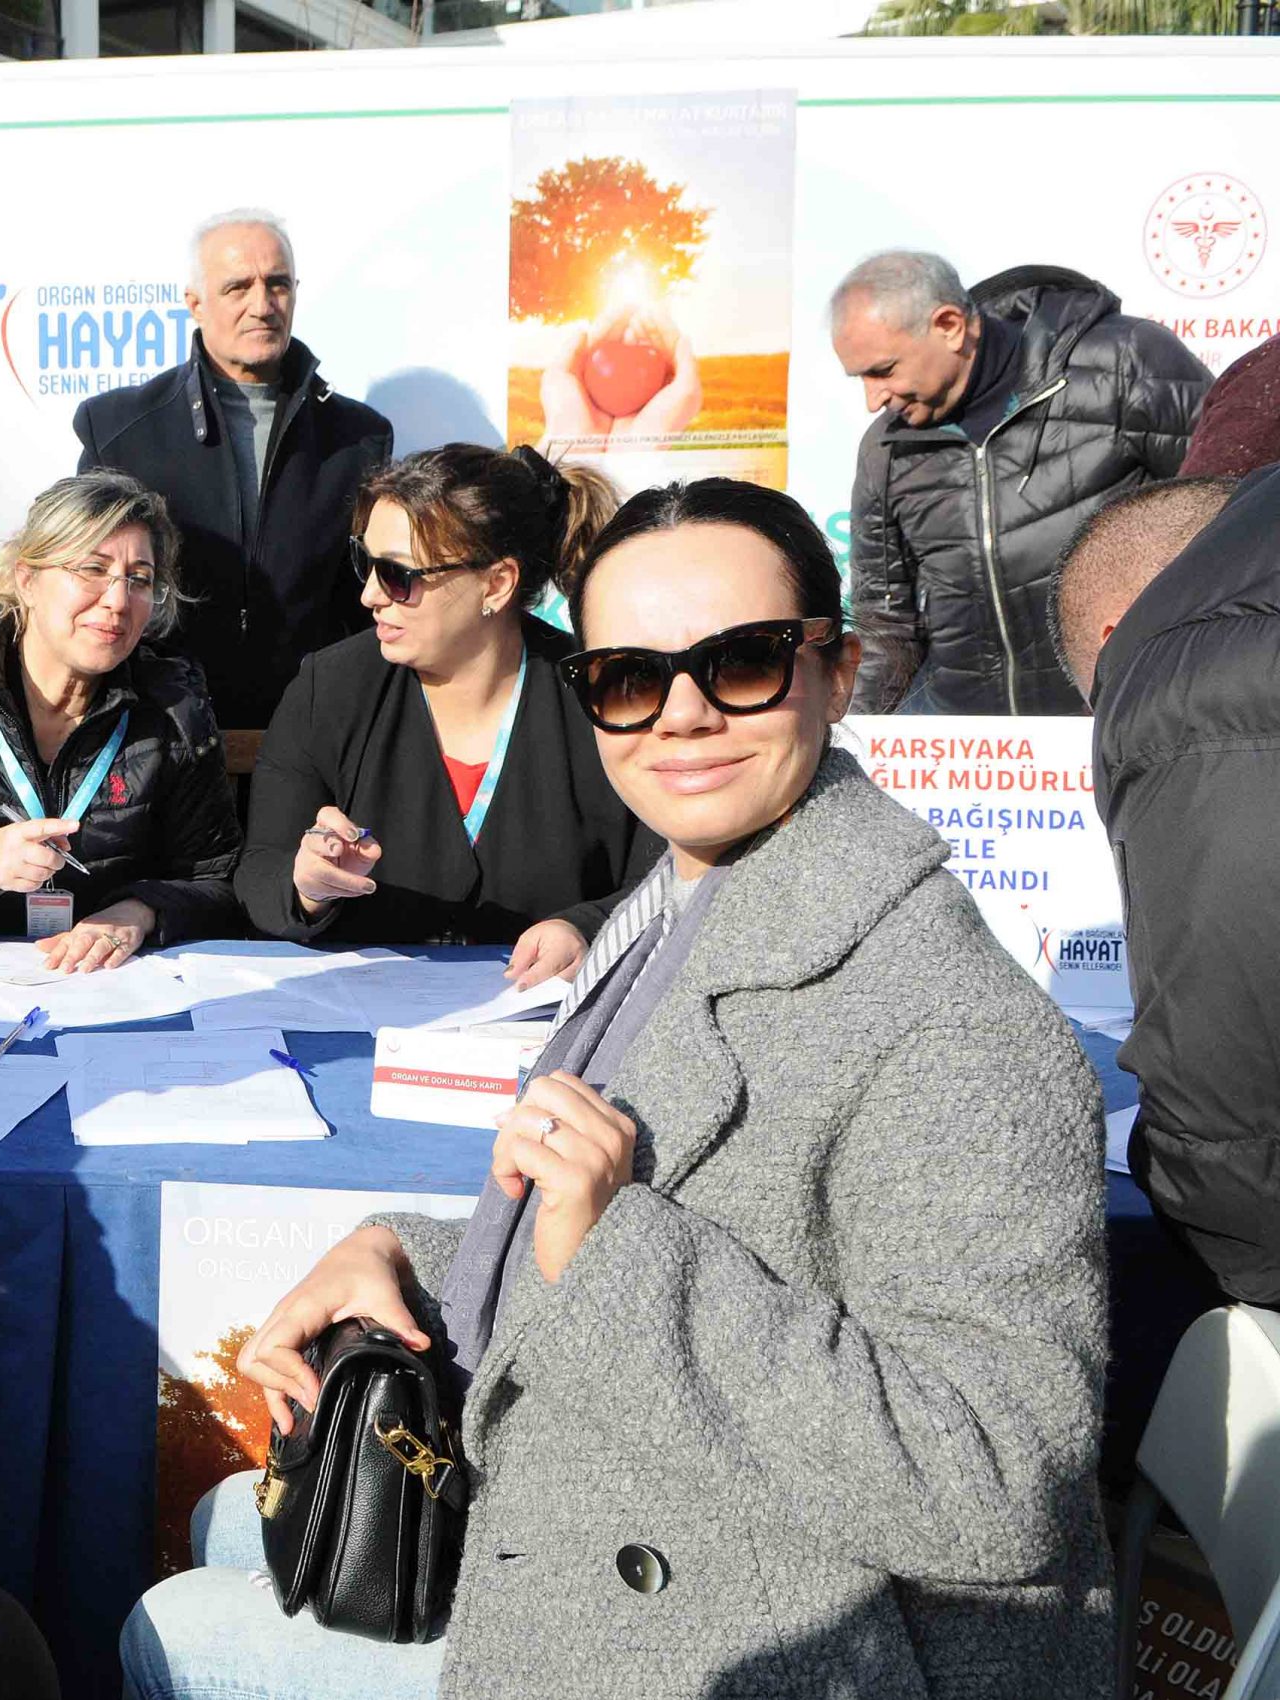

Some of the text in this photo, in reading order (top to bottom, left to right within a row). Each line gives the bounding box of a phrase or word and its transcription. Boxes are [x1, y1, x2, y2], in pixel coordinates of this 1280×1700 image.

[38, 280, 182, 306] ORGAN BAĞIŞINL
[38, 309, 192, 370] HAYAT
[1205, 319, 1280, 338] BAKA
[871, 738, 1034, 766] KARŞIYAKA
[871, 763, 1094, 792] ĞLIK MÜDÜRLÜ
[928, 803, 1085, 835] BAĞIŞINDA
[947, 839, 996, 859] ELE
[949, 869, 1048, 890] TANDI
[1060, 939, 1122, 961] HAYAT
[391, 1072, 419, 1082] ORGAN
[420, 1075, 430, 1083] VE
[455, 1078, 478, 1089] BAĞIŞ
[480, 1080, 502, 1090] KARTI
[184, 1217, 313, 1249] ORGAN
